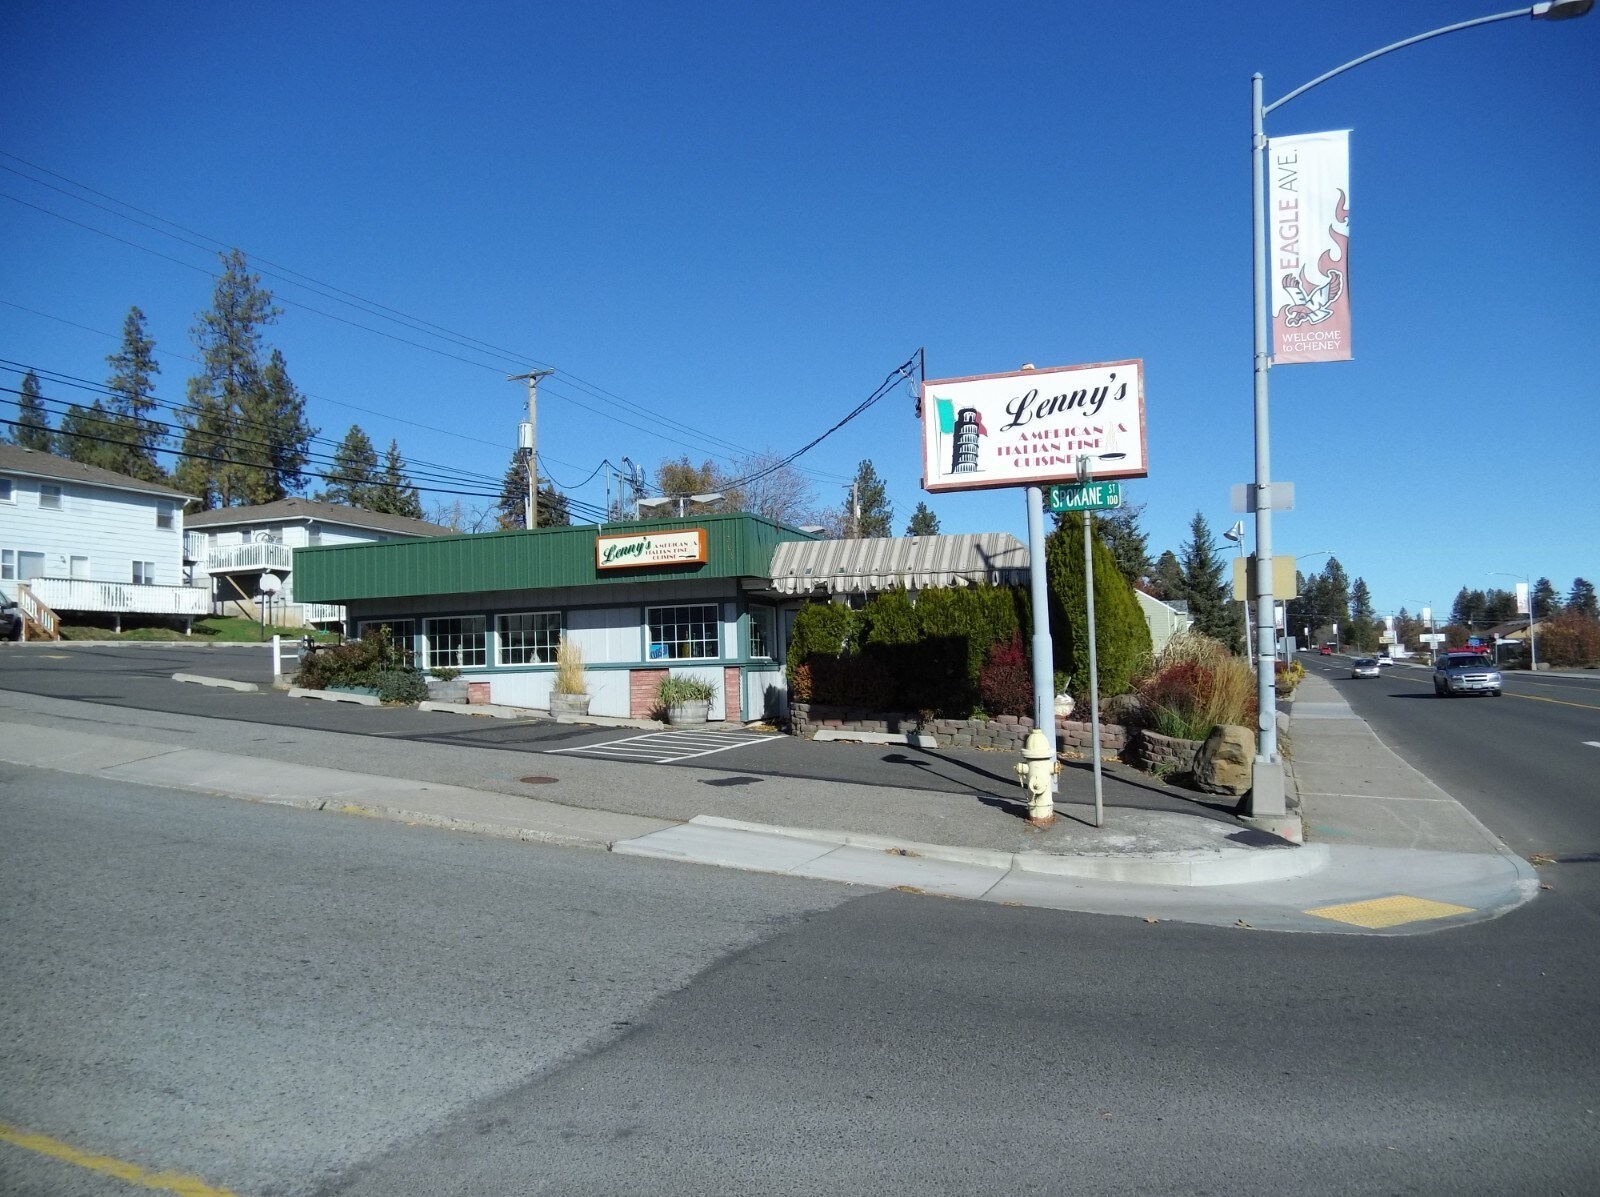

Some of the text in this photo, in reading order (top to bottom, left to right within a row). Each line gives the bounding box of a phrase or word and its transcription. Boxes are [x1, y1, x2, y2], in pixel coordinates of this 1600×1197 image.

[1277, 148, 1300, 270] EAGLE AVE.
[1282, 330, 1341, 343] WELCOME
[1282, 340, 1341, 352] to CHENEY
[1000, 372, 1128, 432] Lenny's
[1019, 425, 1104, 442] AMERICAN
[997, 438, 1104, 457] ITALIAN FINE
[1013, 454, 1075, 468] CUISINE
[1052, 483, 1116, 508] SPOKANE ST
[1106, 494, 1119, 505] 100
[601, 536, 652, 566] Lenny's
